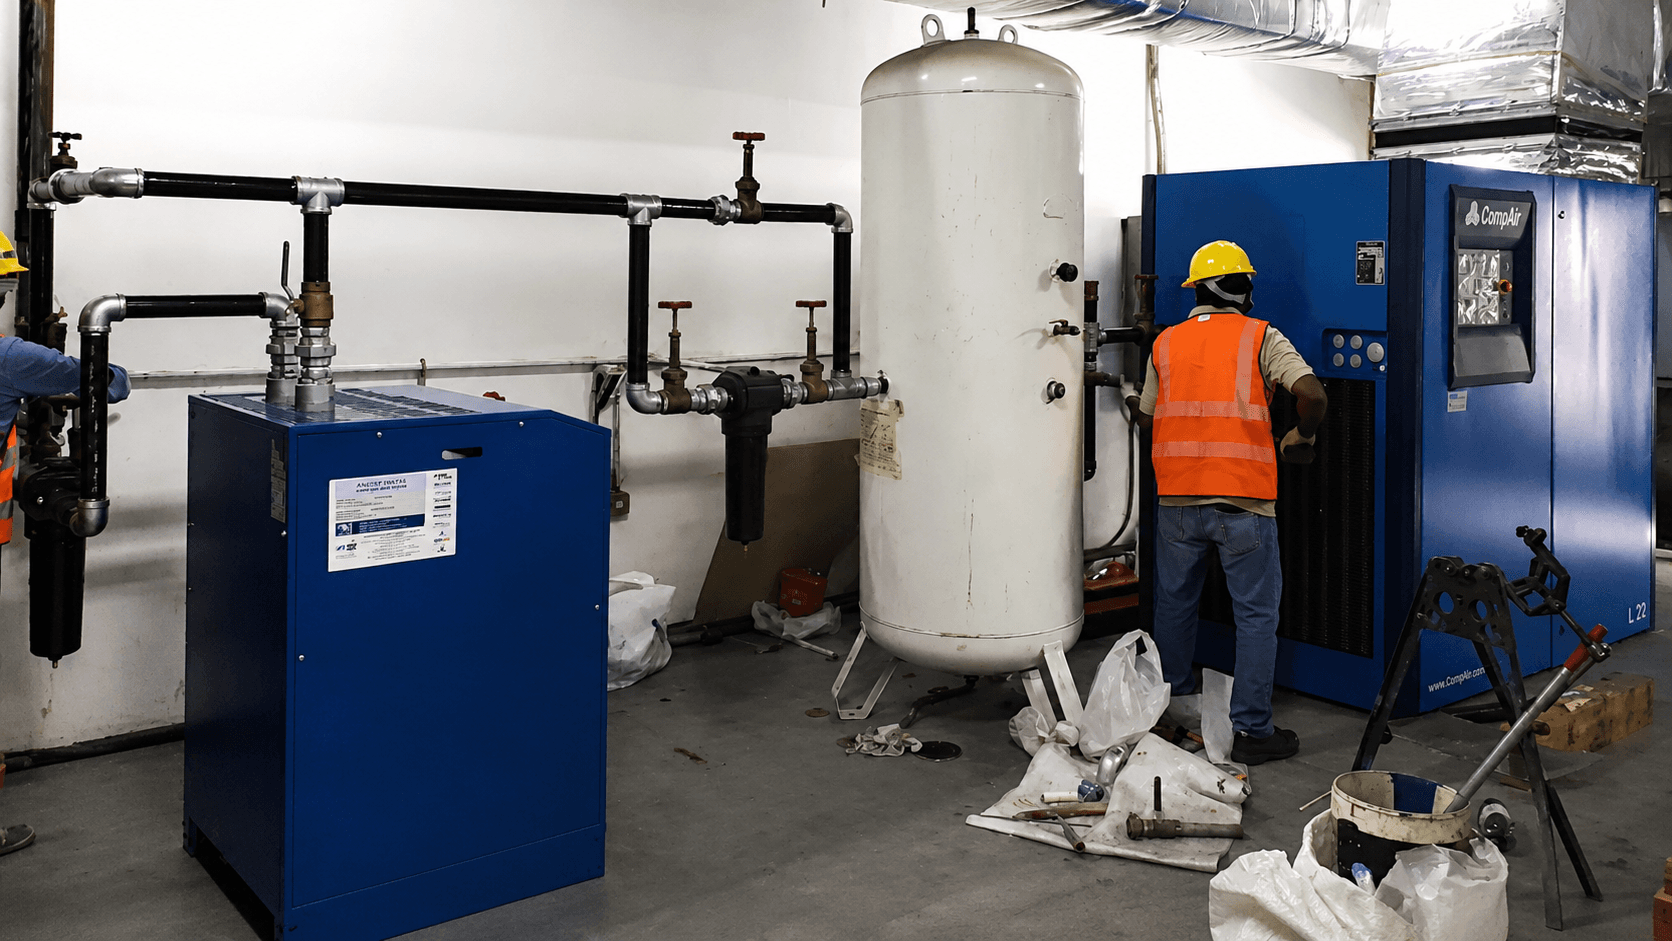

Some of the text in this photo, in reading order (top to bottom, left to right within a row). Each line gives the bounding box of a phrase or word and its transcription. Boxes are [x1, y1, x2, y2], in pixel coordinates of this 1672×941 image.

[1481, 205, 1522, 230] CompAir
[1628, 601, 1647, 624] L 22
